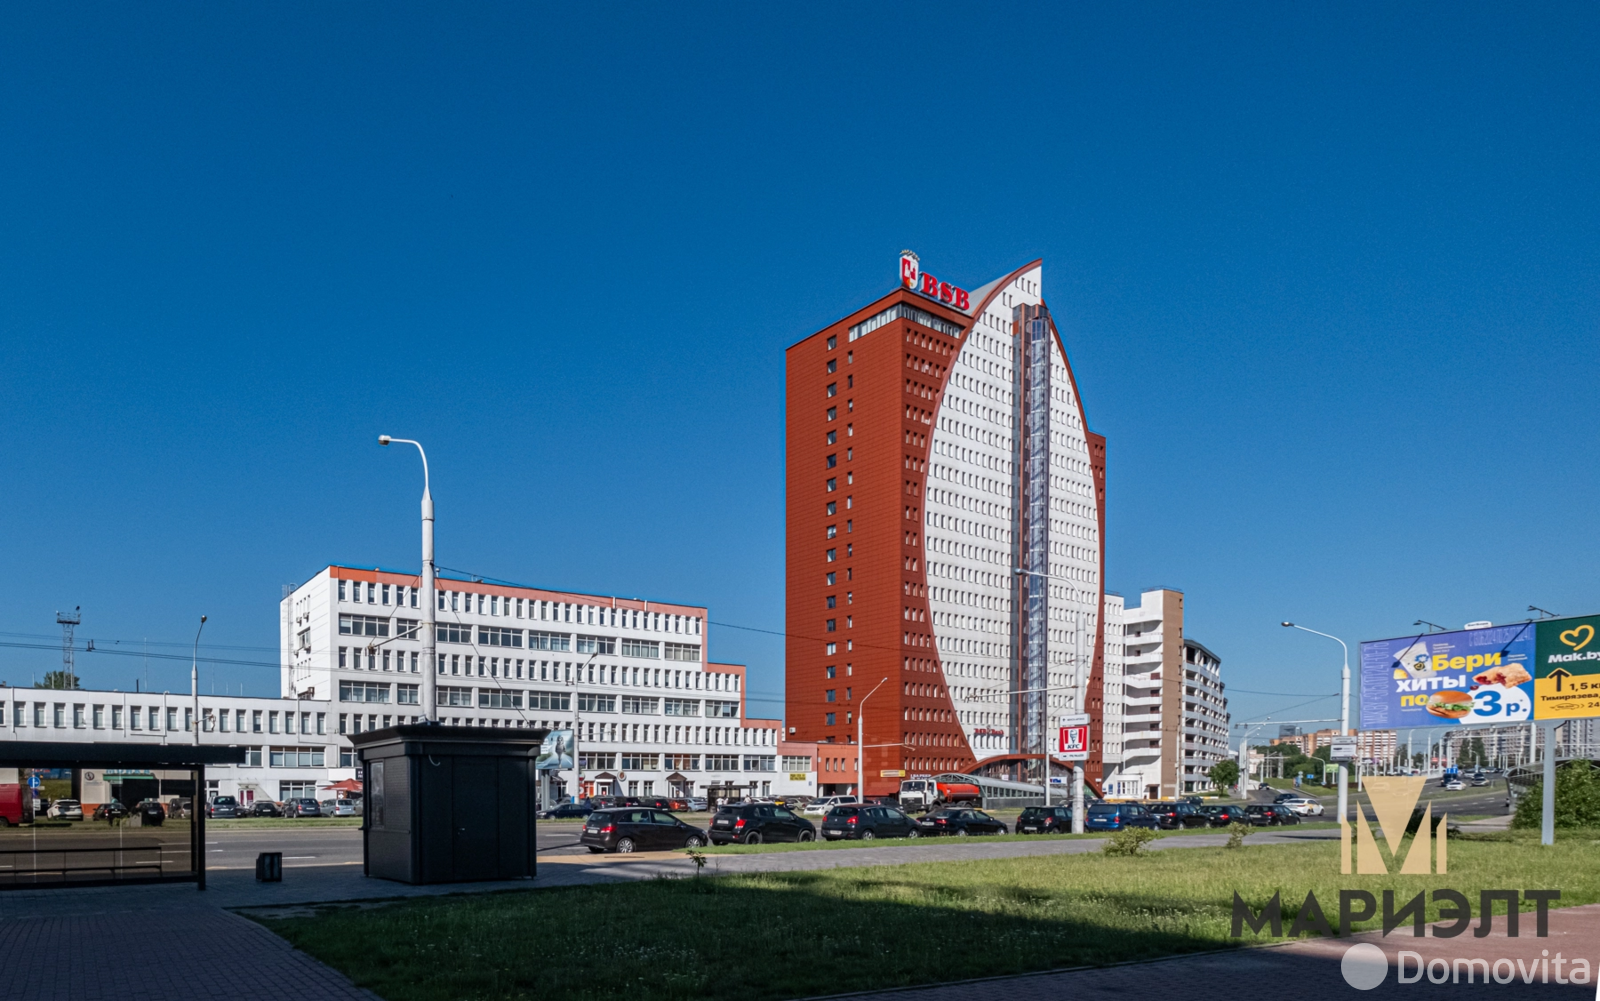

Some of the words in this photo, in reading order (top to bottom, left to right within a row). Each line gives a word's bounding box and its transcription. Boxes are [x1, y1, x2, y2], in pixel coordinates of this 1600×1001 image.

[919, 271, 969, 310] BSB
[1432, 652, 1501, 672] Бери
[1396, 675, 1466, 692] хиты
[1569, 682, 1588, 692] 1,5
[1591, 682, 1600, 690] к
[1401, 694, 1429, 707] по
[1473, 690, 1502, 716] 3
